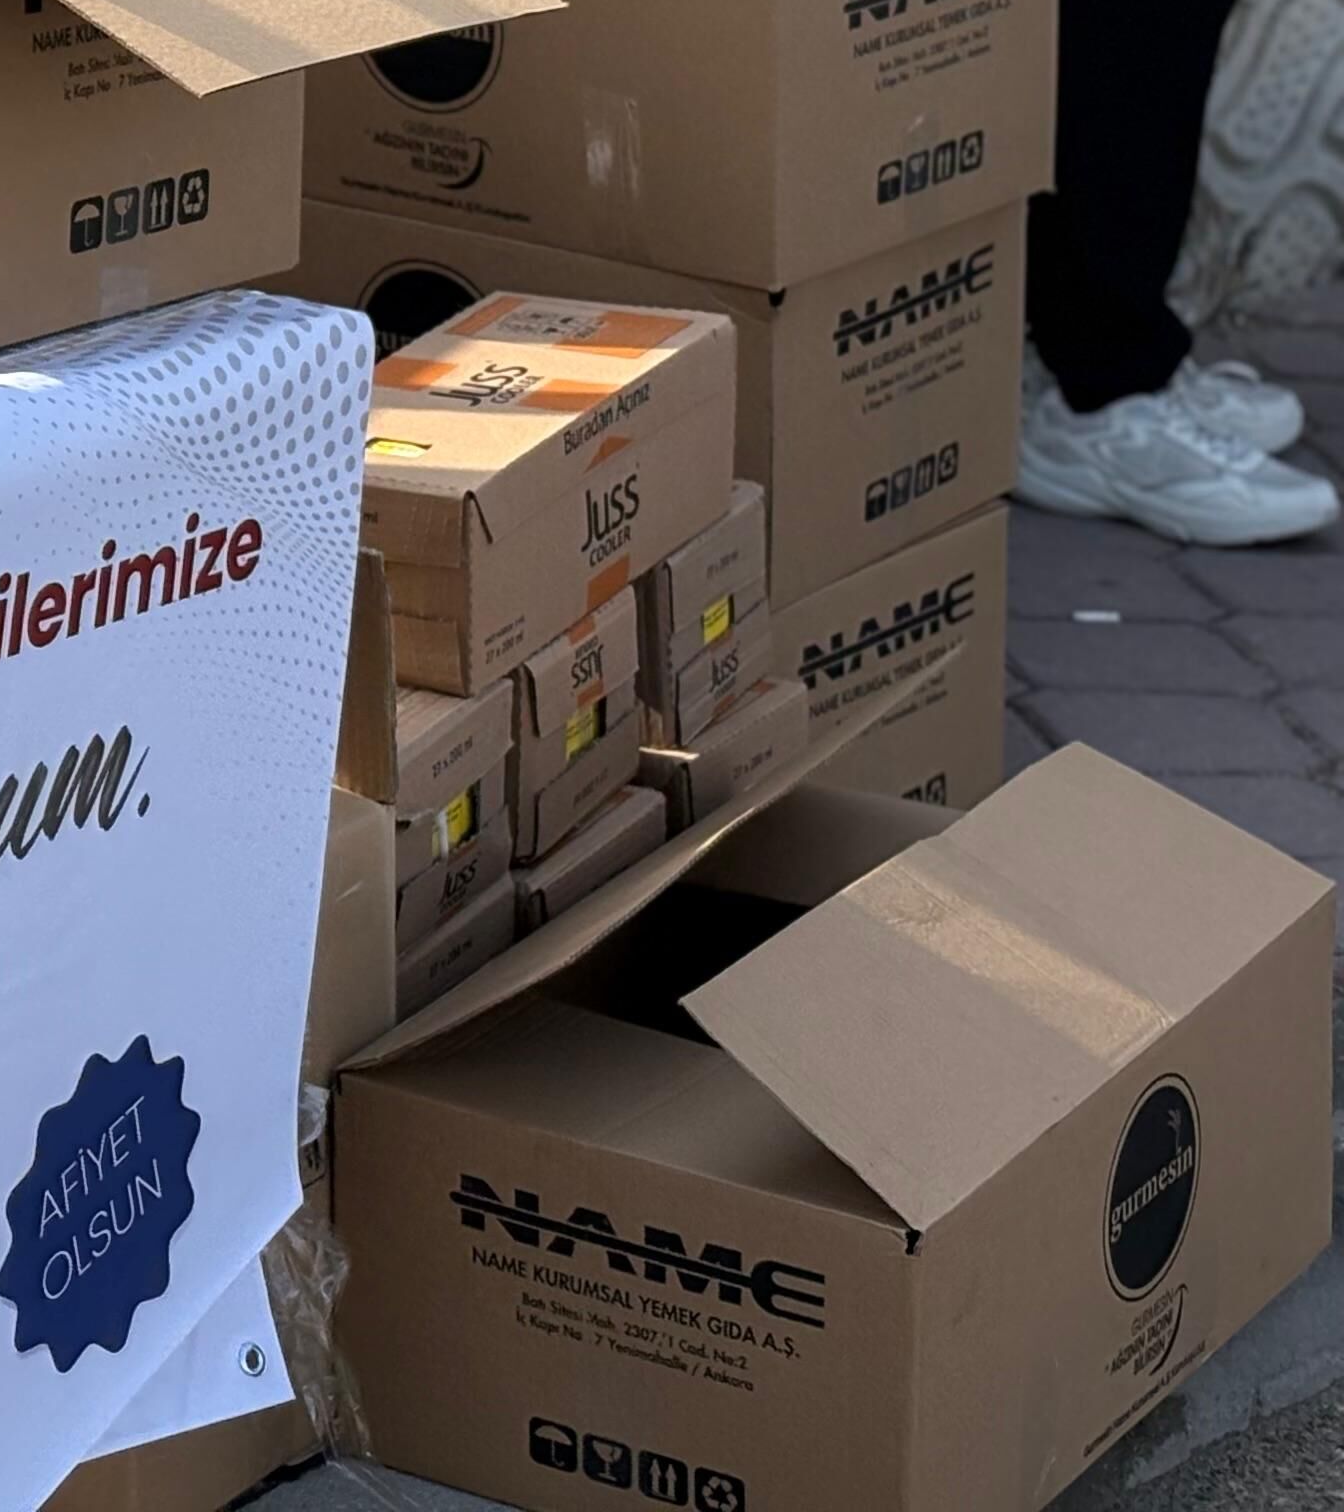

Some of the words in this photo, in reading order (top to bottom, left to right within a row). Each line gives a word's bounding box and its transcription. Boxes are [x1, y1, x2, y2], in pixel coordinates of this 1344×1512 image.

[833, 242, 994, 357] NAME
[562, 406, 614, 456] Buradan
[581, 472, 641, 553] Juss
[588, 528, 632, 568] COOLER
[798, 572, 974, 690] NAME
[39, 1095, 145, 1240] AFİYET
[1110, 1143, 1194, 1243] gurmesin
[42, 1158, 162, 1300] OLSUN
[449, 1173, 825, 1329] NAME
[471, 1246, 528, 1278] NAME
[533, 1266, 633, 1310] KURUMSAL
[639, 1295, 702, 1332] YEMEK
